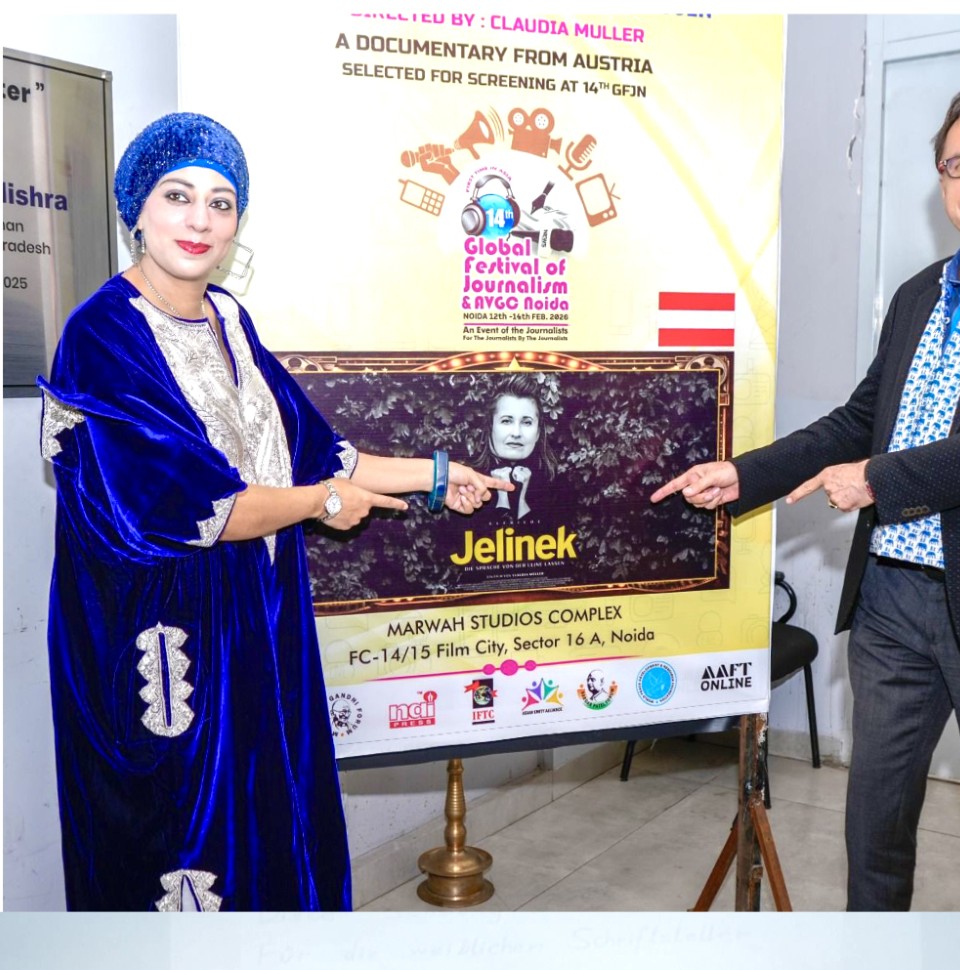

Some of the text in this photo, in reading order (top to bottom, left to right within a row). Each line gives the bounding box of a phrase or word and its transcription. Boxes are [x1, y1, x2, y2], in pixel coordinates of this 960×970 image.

[490, 15, 569, 36] CLAUDIA
[574, 23, 645, 43] MULLER
[335, 33, 653, 74] A DOCUMENTARY FROM AUSTRIA
[342, 62, 425, 81] SELECTED
[431, 69, 462, 84] FOR
[467, 72, 556, 91] SCREENING
[560, 80, 579, 92] AT
[612, 84, 647, 98] GFJN
[3, 83, 31, 103] er
[3, 182, 68, 211] ishra
[3, 221, 24, 232] an
[486, 208, 514, 228] 14th
[464, 237, 531, 256] Global
[464, 256, 566, 275] Festival of
[463, 275, 568, 294] Journalism
[462, 295, 569, 311] & AVGC Noida
[463, 312, 487, 320] NOIDA
[489, 312, 507, 320] 12th
[550, 313, 569, 321] 2026
[463, 326, 569, 335] An Event of the Journalists
[450, 525, 578, 565] Jelinek
[387, 605, 623, 638] MARWAH STUDIOS COMPLEX
[349, 629, 655, 666] FC-14/15 Film City, Sector 16 A, Noida
[700, 676, 752, 692] ONLINE
[329, 692, 363, 736] GANDHI FORUM
[472, 709, 495, 721] IFTC
